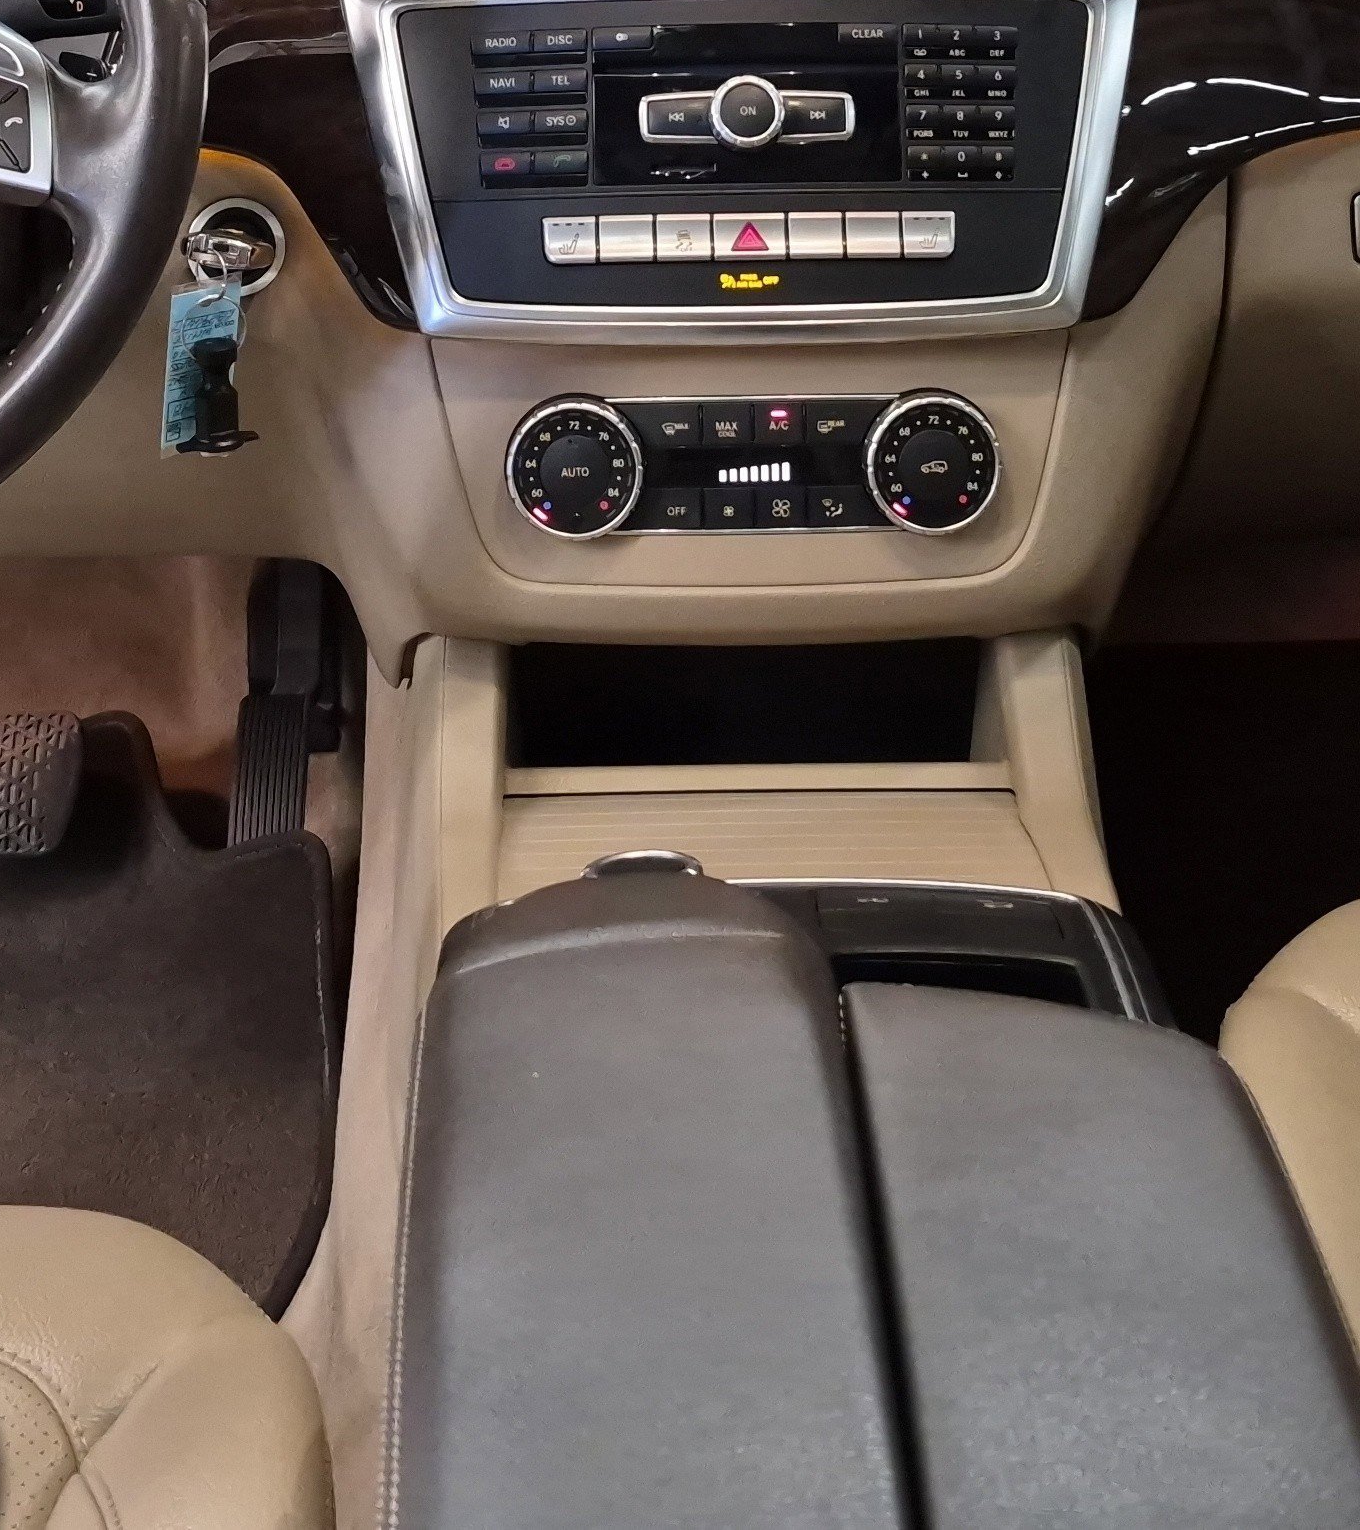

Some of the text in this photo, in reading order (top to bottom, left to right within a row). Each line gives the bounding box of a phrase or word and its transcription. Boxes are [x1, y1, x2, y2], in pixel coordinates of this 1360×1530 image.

[76, 1, 84, 12] D
[852, 29, 884, 39] CLEAR
[918, 29, 923, 40] 1
[953, 30, 960, 41] 2
[994, 31, 1001, 41] 3
[485, 36, 517, 48] RADIO
[547, 35, 573, 46] DISC
[949, 49, 966, 57] ABC
[551, 75, 570, 85] TEL
[917, 70, 925, 80] 4
[955, 70, 963, 80] 5
[994, 71, 1002, 80] 6
[490, 77, 516, 88] NAVI
[740, 105, 757, 116] ON
[919, 110, 927, 120] 7
[956, 110, 964, 121] 8
[546, 116, 565, 126] SYS
[995, 111, 1003, 121] 9
[957, 151, 965, 162] 0
[769, 420, 789, 430] A/C
[928, 415, 940, 425] 72
[568, 421, 580, 430] 72
[715, 421, 738, 431] MAX
[958, 426, 969, 435] 76
[899, 426, 911, 436] 68
[539, 432, 551, 442] 68
[598, 432, 610, 441] 76
[884, 454, 897, 463] 64
[971, 452, 984, 462] 80
[525, 459, 537, 469] 64
[612, 458, 625, 468] 80
[561, 466, 590, 477] AUTO
[890, 483, 903, 493] 60
[966, 481, 979, 491] 84
[531, 488, 543, 498] 60
[607, 488, 620, 497] 84
[667, 506, 687, 516] OFF
